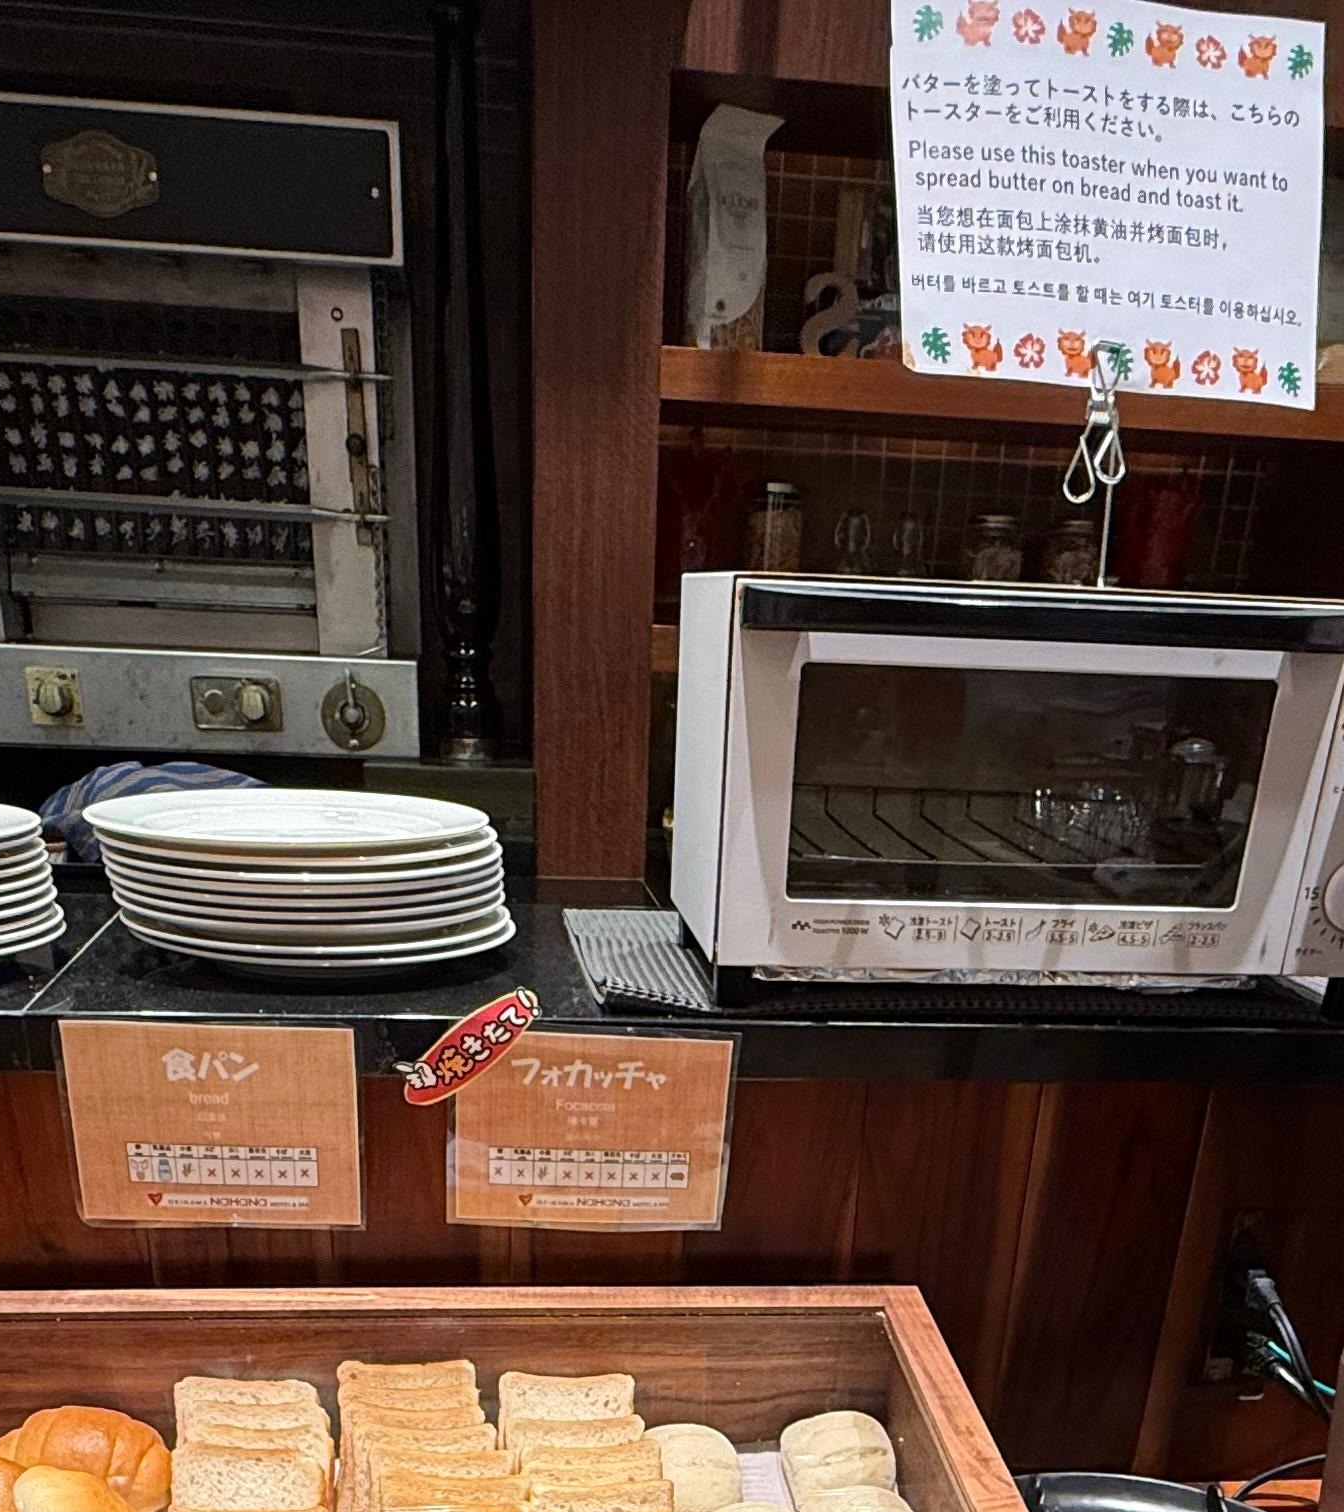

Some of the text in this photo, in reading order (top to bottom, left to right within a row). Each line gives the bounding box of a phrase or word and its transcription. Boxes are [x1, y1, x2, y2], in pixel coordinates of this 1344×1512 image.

[907, 100, 1163, 143] トースターをご利用ください。
[908, 140, 1288, 192] Please use this toaster when you want to
[915, 168, 1244, 213] spread butter on bread and toast it.
[917, 231, 1101, 264] 请使用这款烤面包机。
[911, 273, 1302, 327] 버터를 바르고 토스트를 할 때는 여기 토스터를 이용하십시오.
[1304, 886, 1320, 901] 15
[161, 1048, 260, 1082] 食パン
[511, 1057, 668, 1091] フォカッチャ
[188, 1091, 229, 1105] bread
